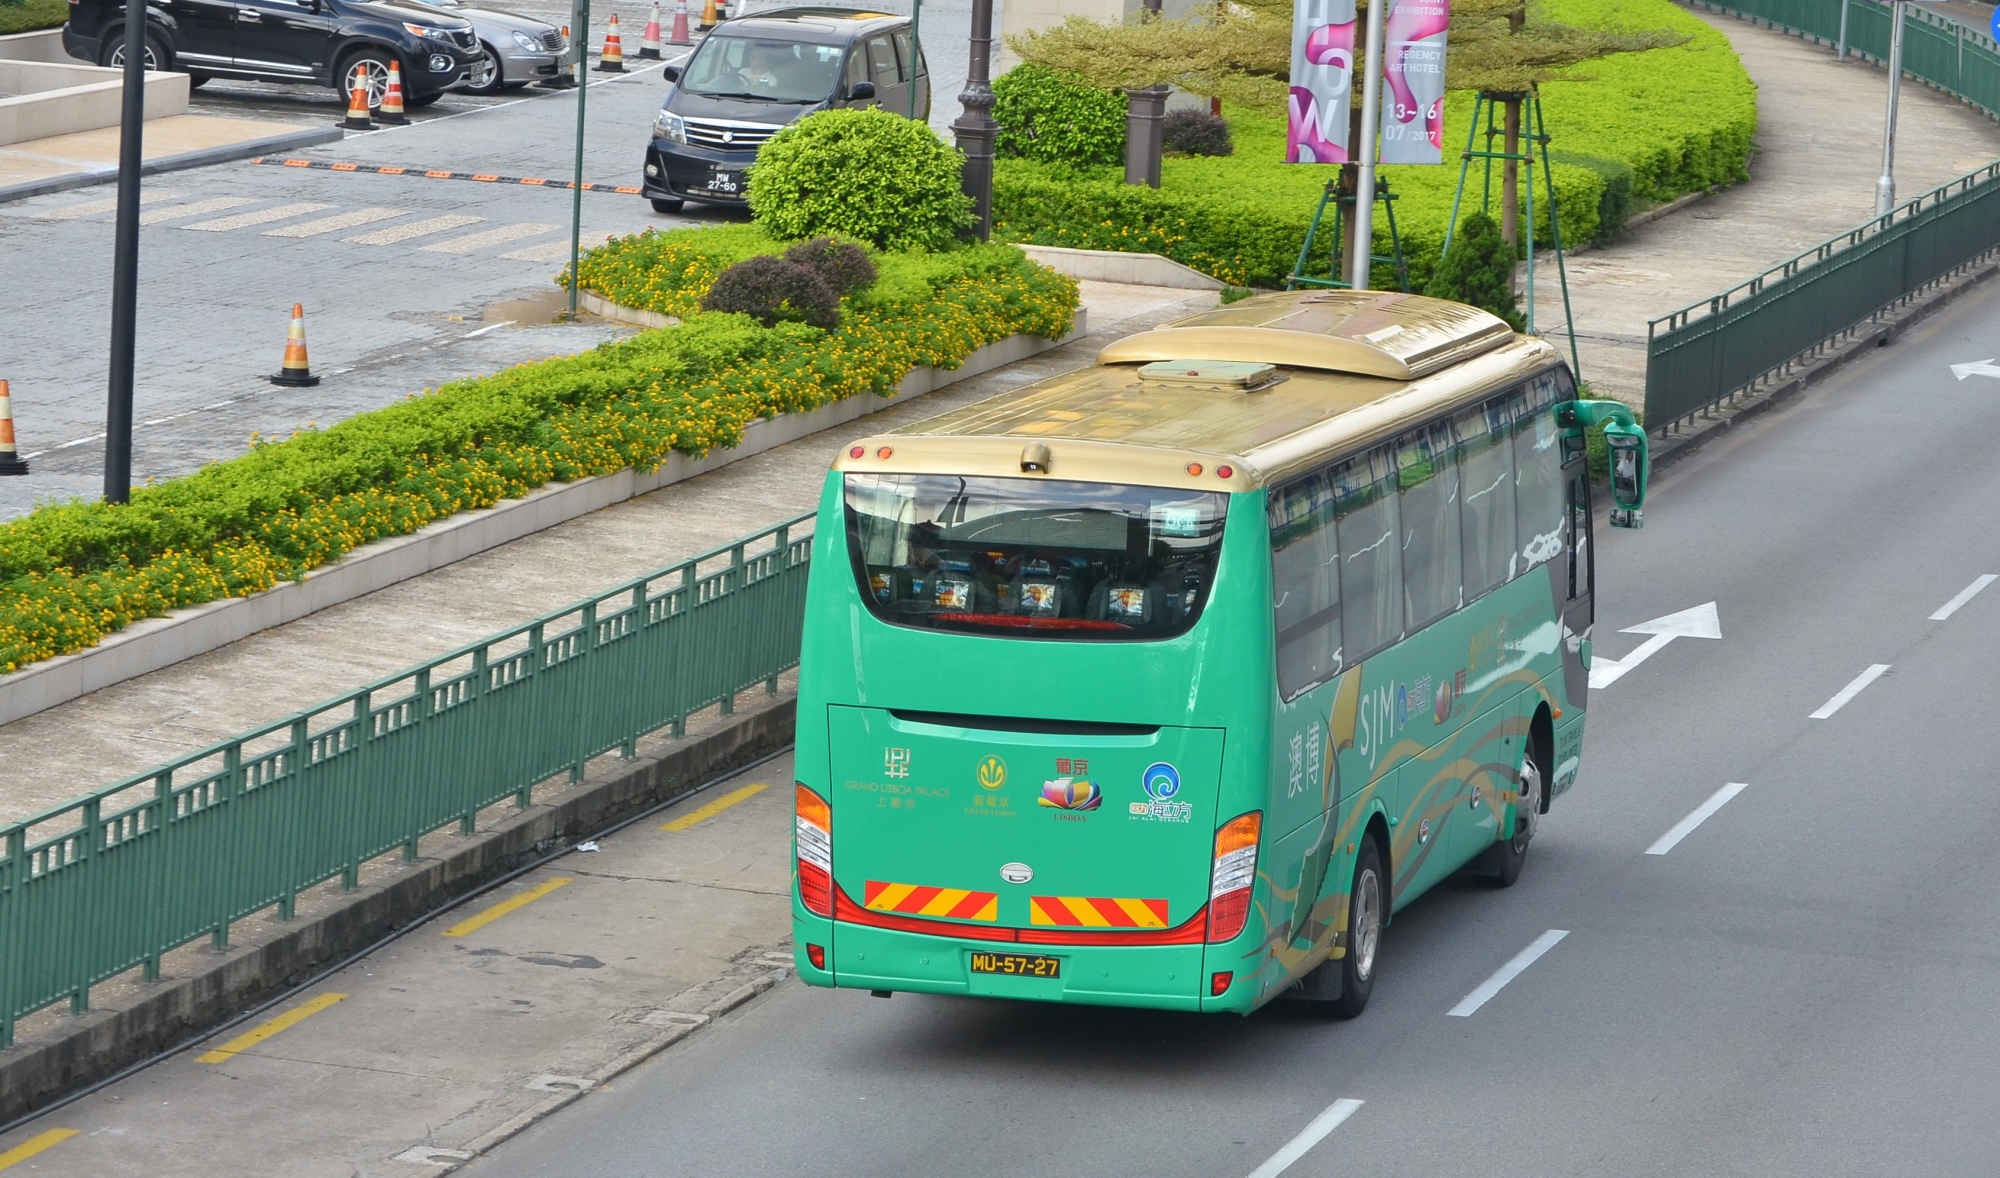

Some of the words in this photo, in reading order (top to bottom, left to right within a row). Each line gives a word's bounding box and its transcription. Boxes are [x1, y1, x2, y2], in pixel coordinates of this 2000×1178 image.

[1394, 5, 1445, 16] EXHIBITION
[1397, 50, 1442, 60] REGENCY
[1389, 63, 1407, 72] ART
[1409, 64, 1441, 74] HOTEL
[716, 173, 729, 182] MW
[707, 180, 737, 191] 27-60
[1360, 679, 1395, 770] SJM
[1287, 720, 1321, 799] 澳博
[1055, 757, 1089, 776] 葡京
[844, 780, 879, 792] GRAND
[880, 784, 913, 795] LISBOA
[914, 786, 950, 798] PALACE
[1053, 813, 1087, 822] LISBOA
[973, 954, 1058, 976] MU-57-27
